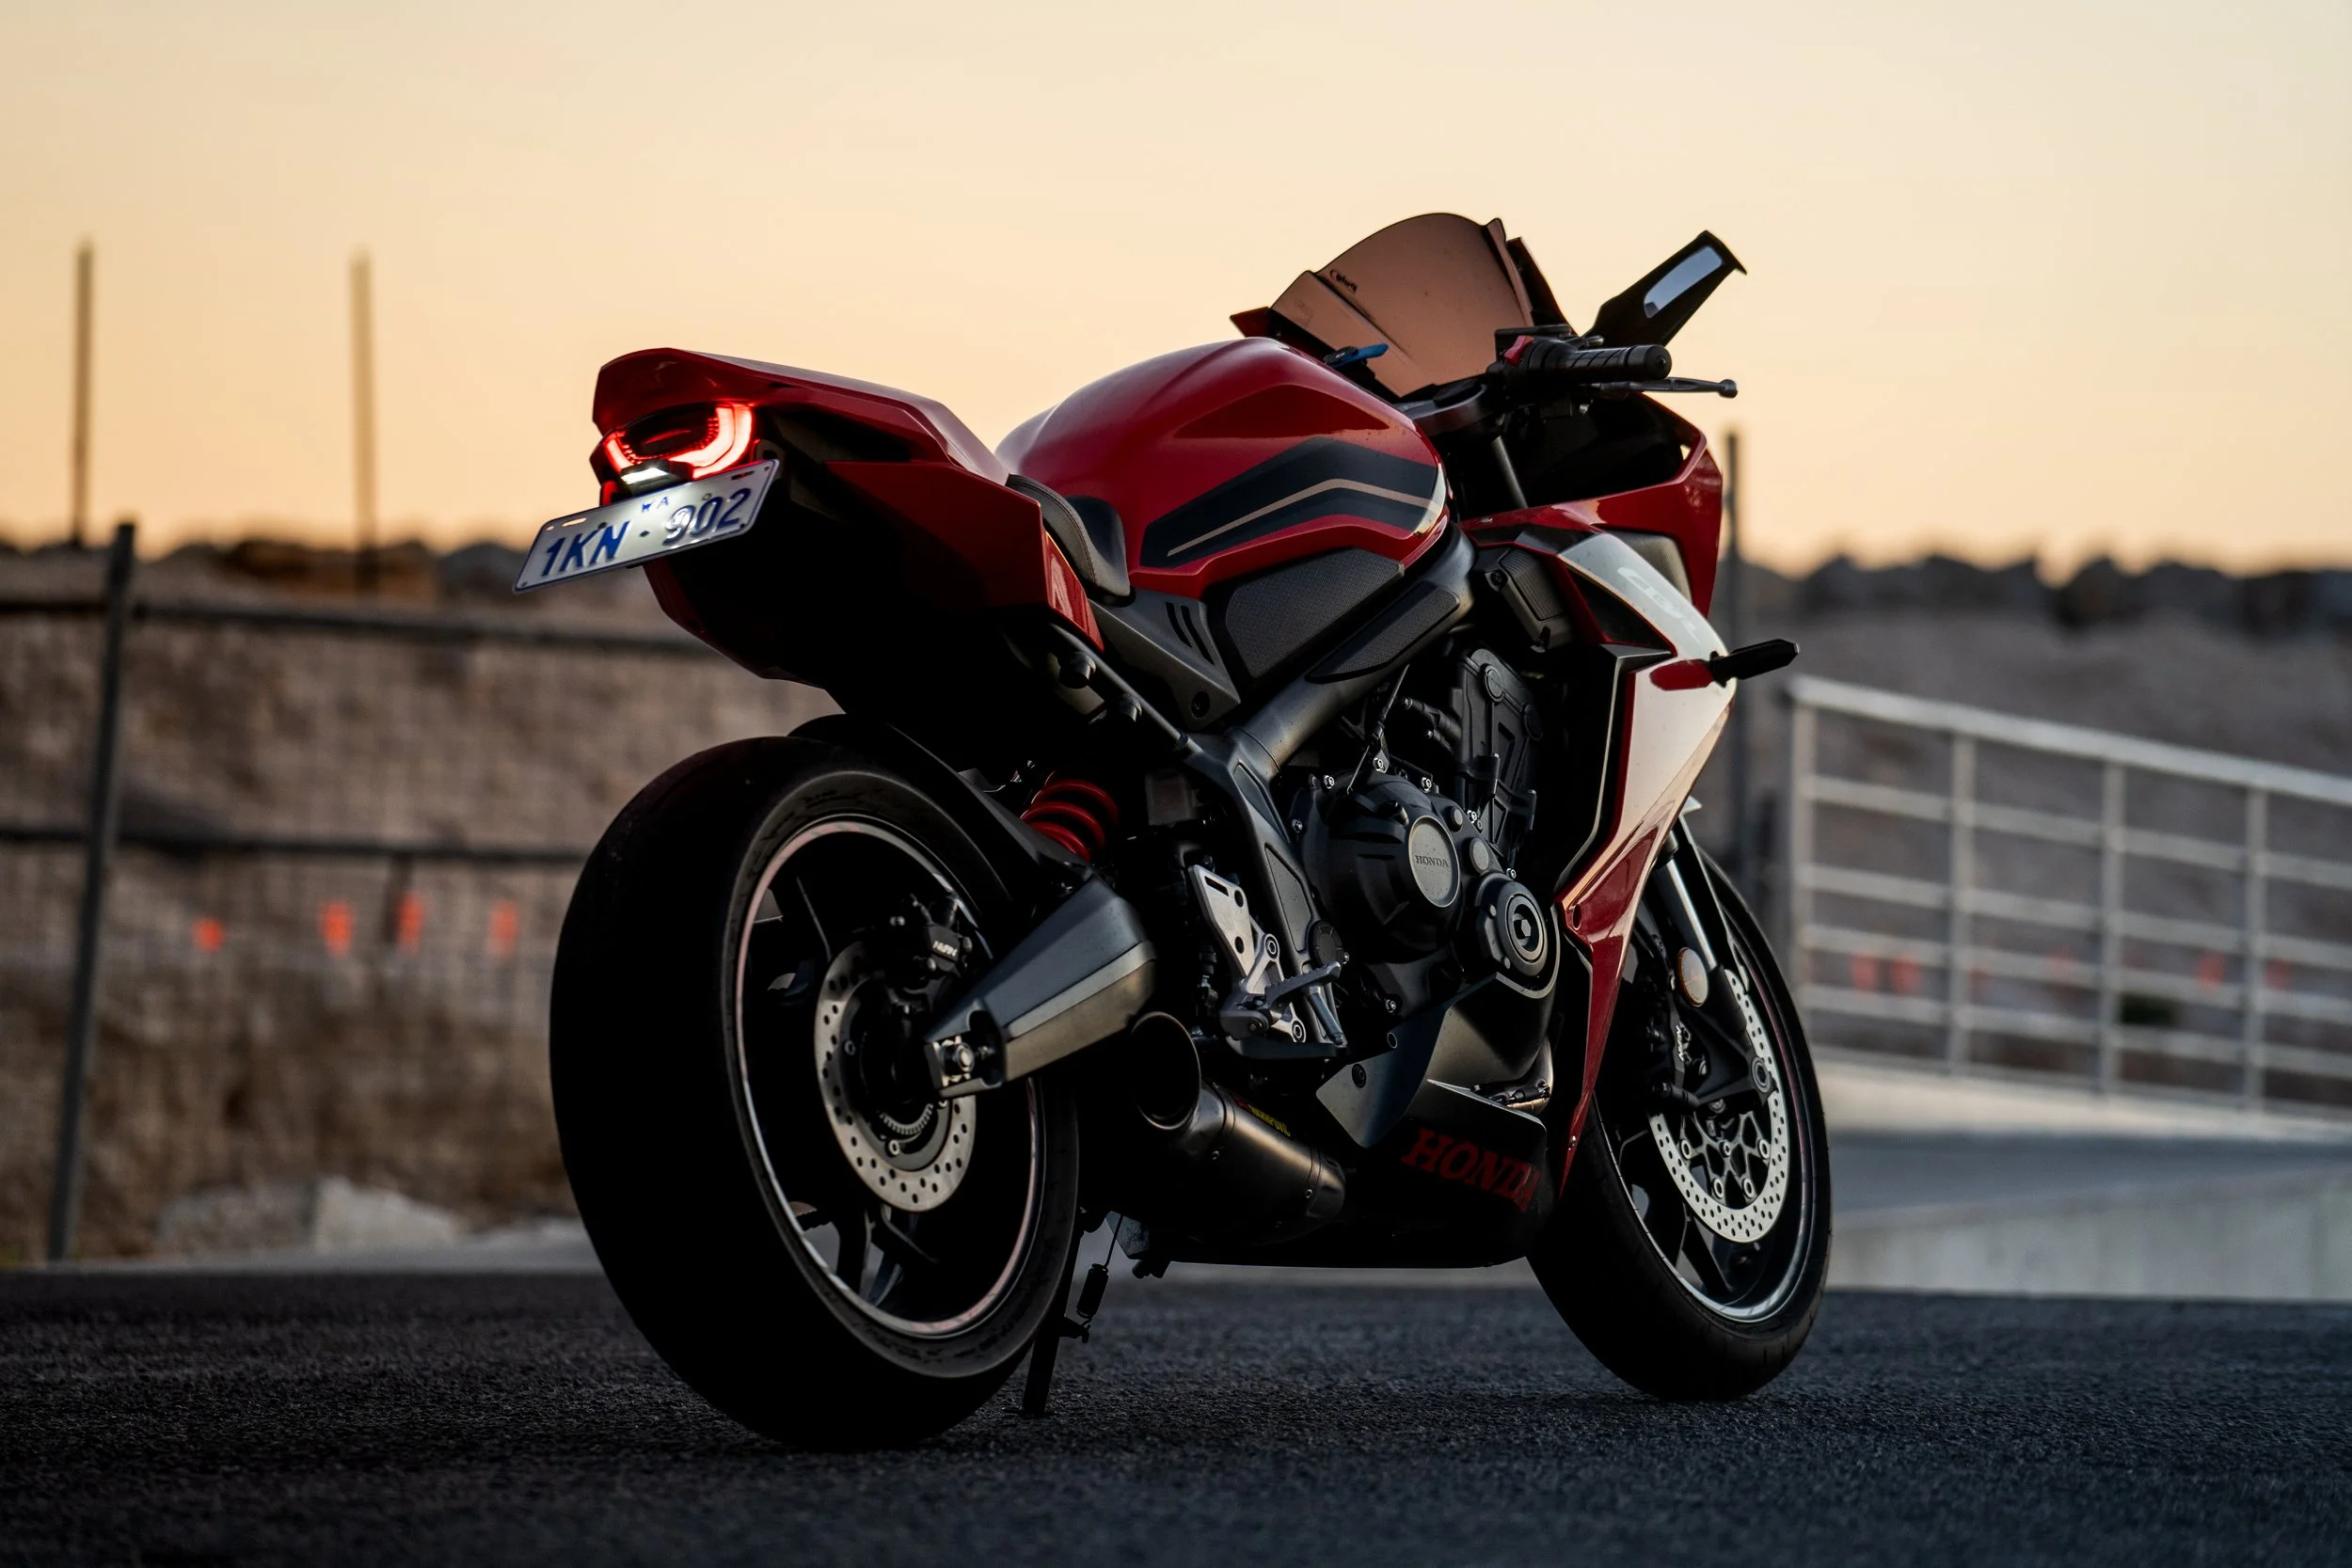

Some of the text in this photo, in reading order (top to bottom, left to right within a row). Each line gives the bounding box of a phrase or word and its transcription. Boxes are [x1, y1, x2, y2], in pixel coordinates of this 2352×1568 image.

[541, 487, 752, 577] 1KN 902
[1414, 854, 1450, 867] HONDA
